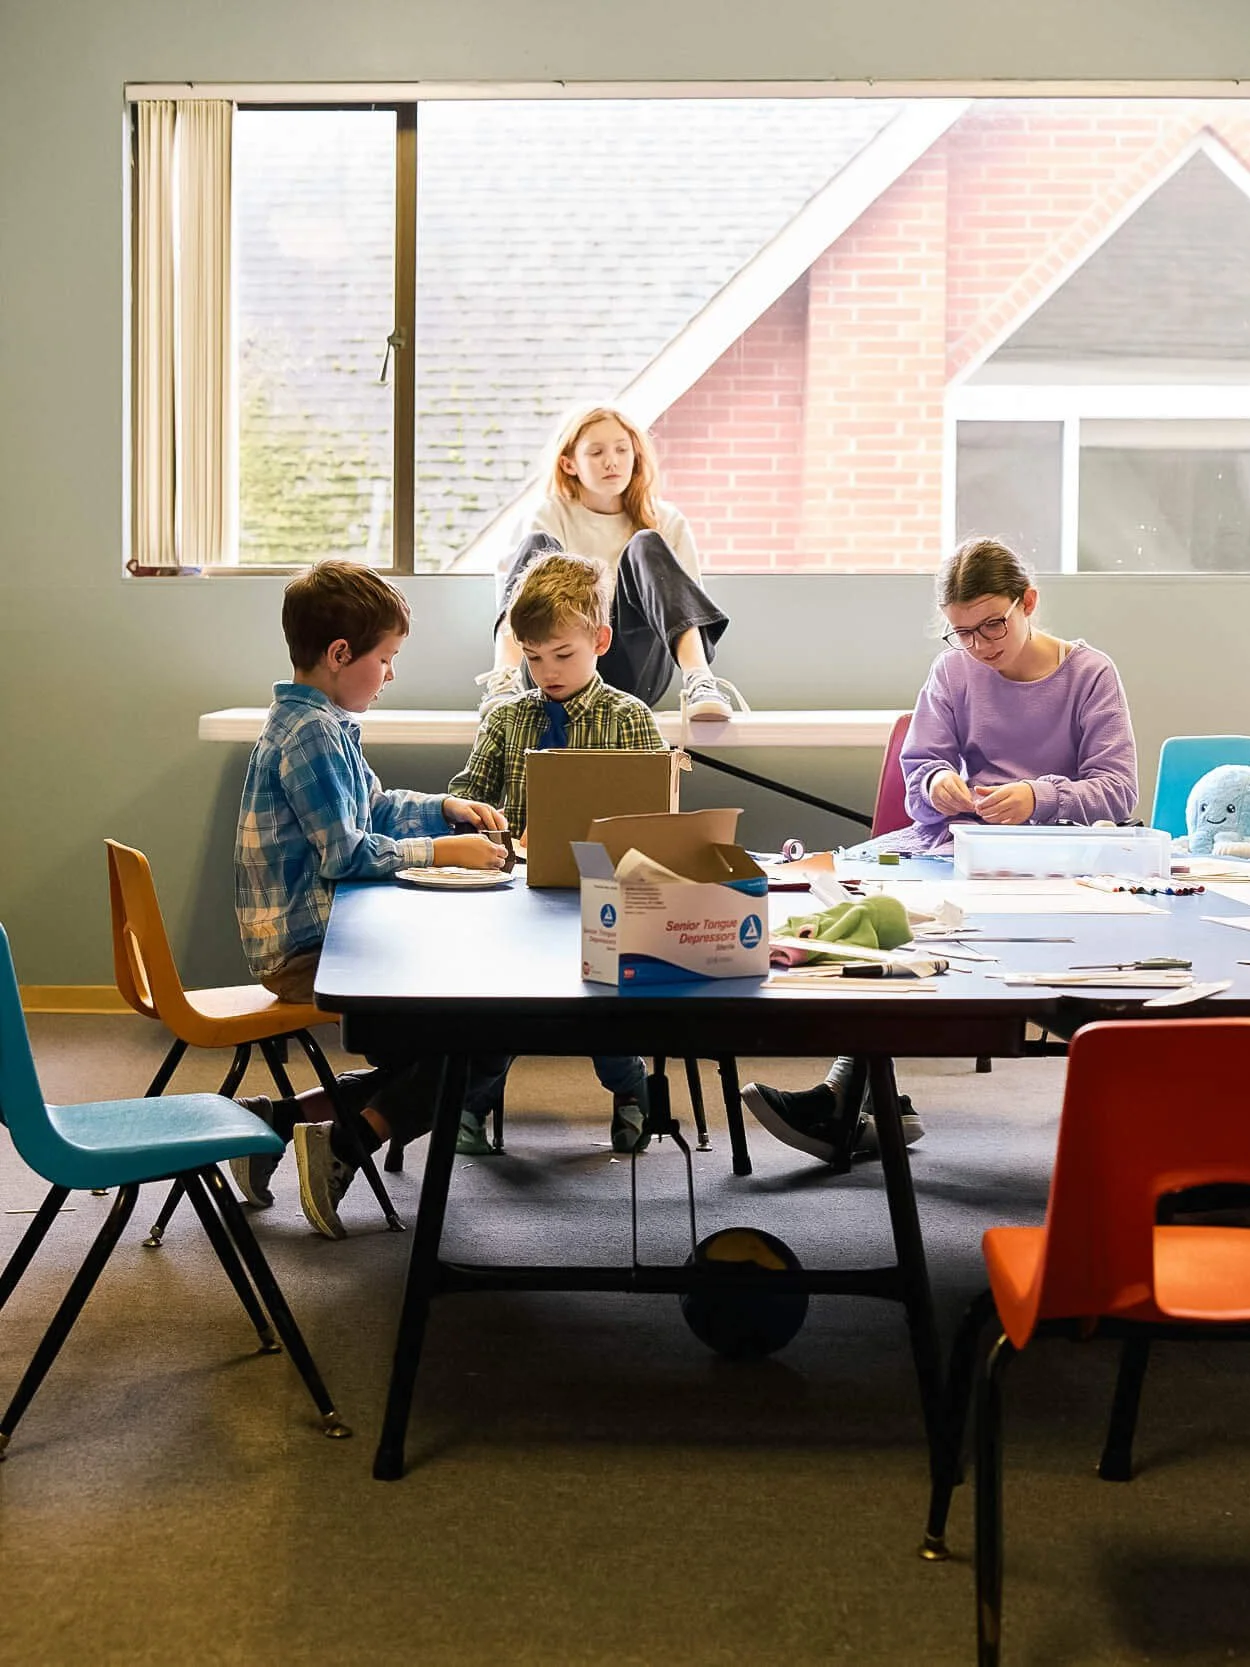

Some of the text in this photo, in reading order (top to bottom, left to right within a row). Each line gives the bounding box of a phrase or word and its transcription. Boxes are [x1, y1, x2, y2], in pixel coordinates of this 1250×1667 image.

[665, 919, 738, 931] Senior Tongue
[679, 932, 737, 944] Depressors
